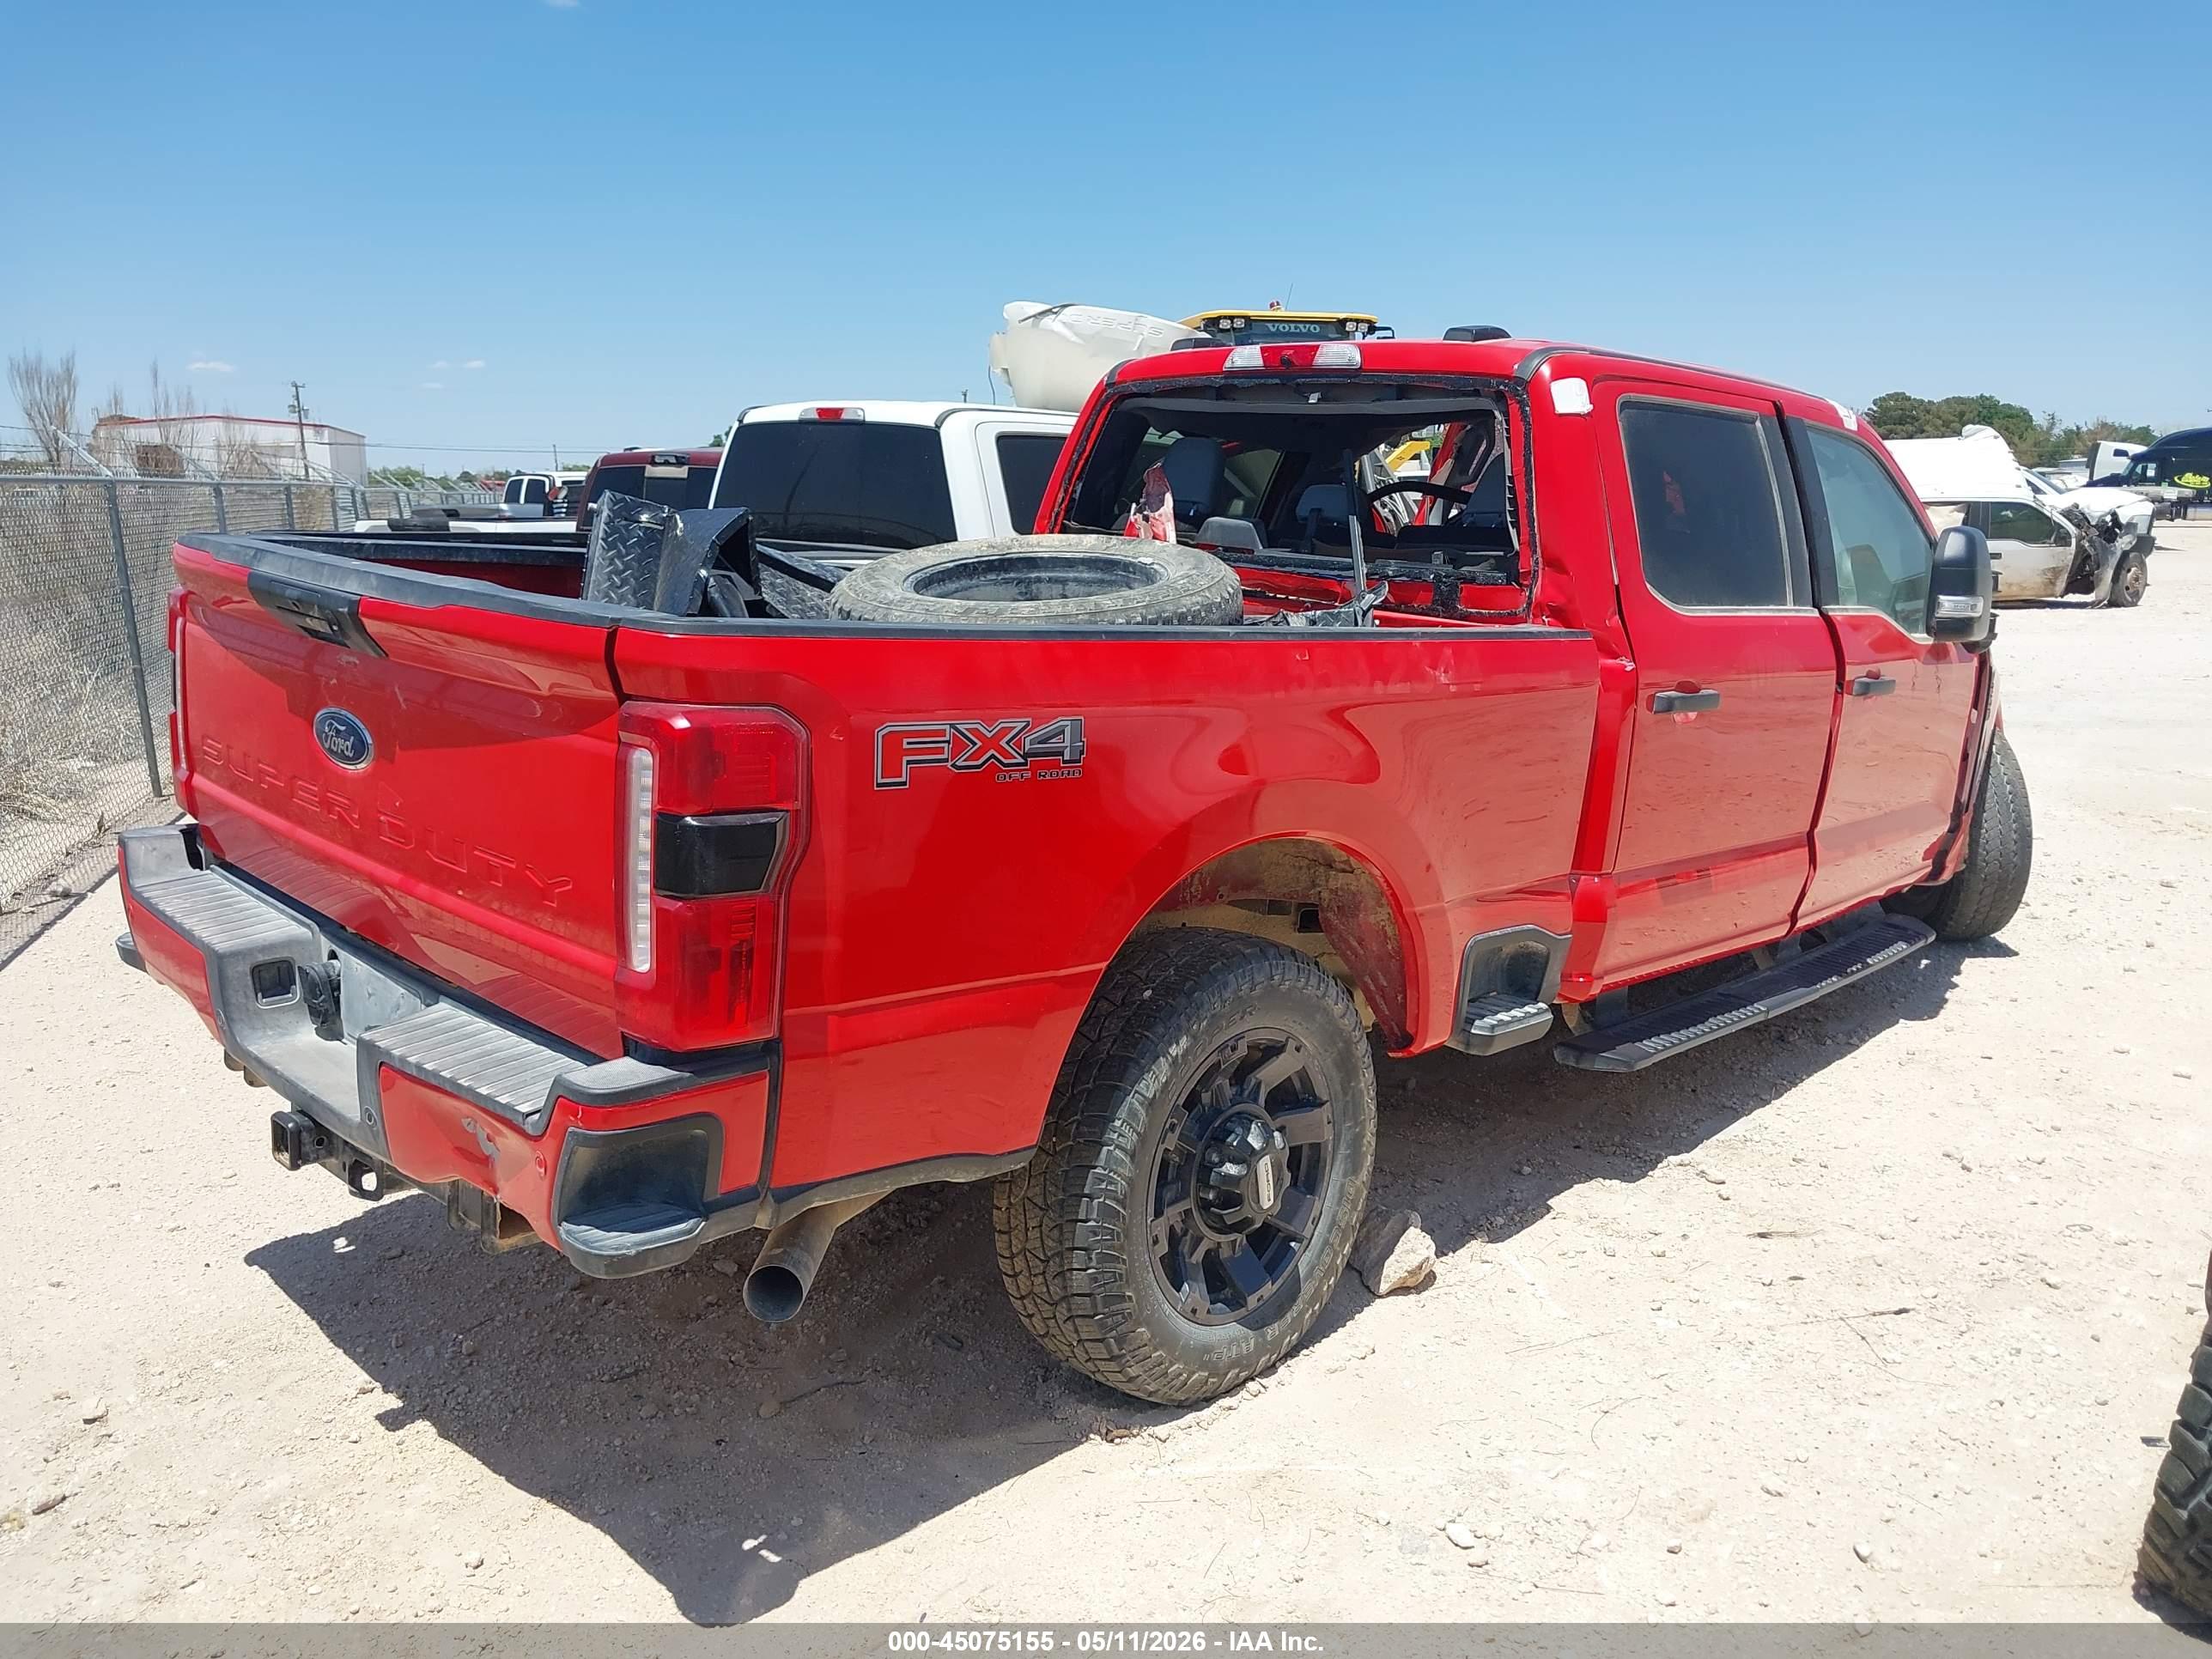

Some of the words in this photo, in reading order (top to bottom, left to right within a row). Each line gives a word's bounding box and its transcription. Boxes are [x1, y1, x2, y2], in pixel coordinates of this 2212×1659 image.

[1266, 323, 1321, 333] VOLVO
[322, 719, 355, 758] Ford
[874, 716, 1086, 790] FX4
[995, 770, 1032, 783] OFF
[1036, 769, 1083, 781] ROAD
[203, 733, 360, 830] SUPER
[377, 811, 573, 908] DUTY
[1265, 1176, 1357, 1341] DISCOVERER
